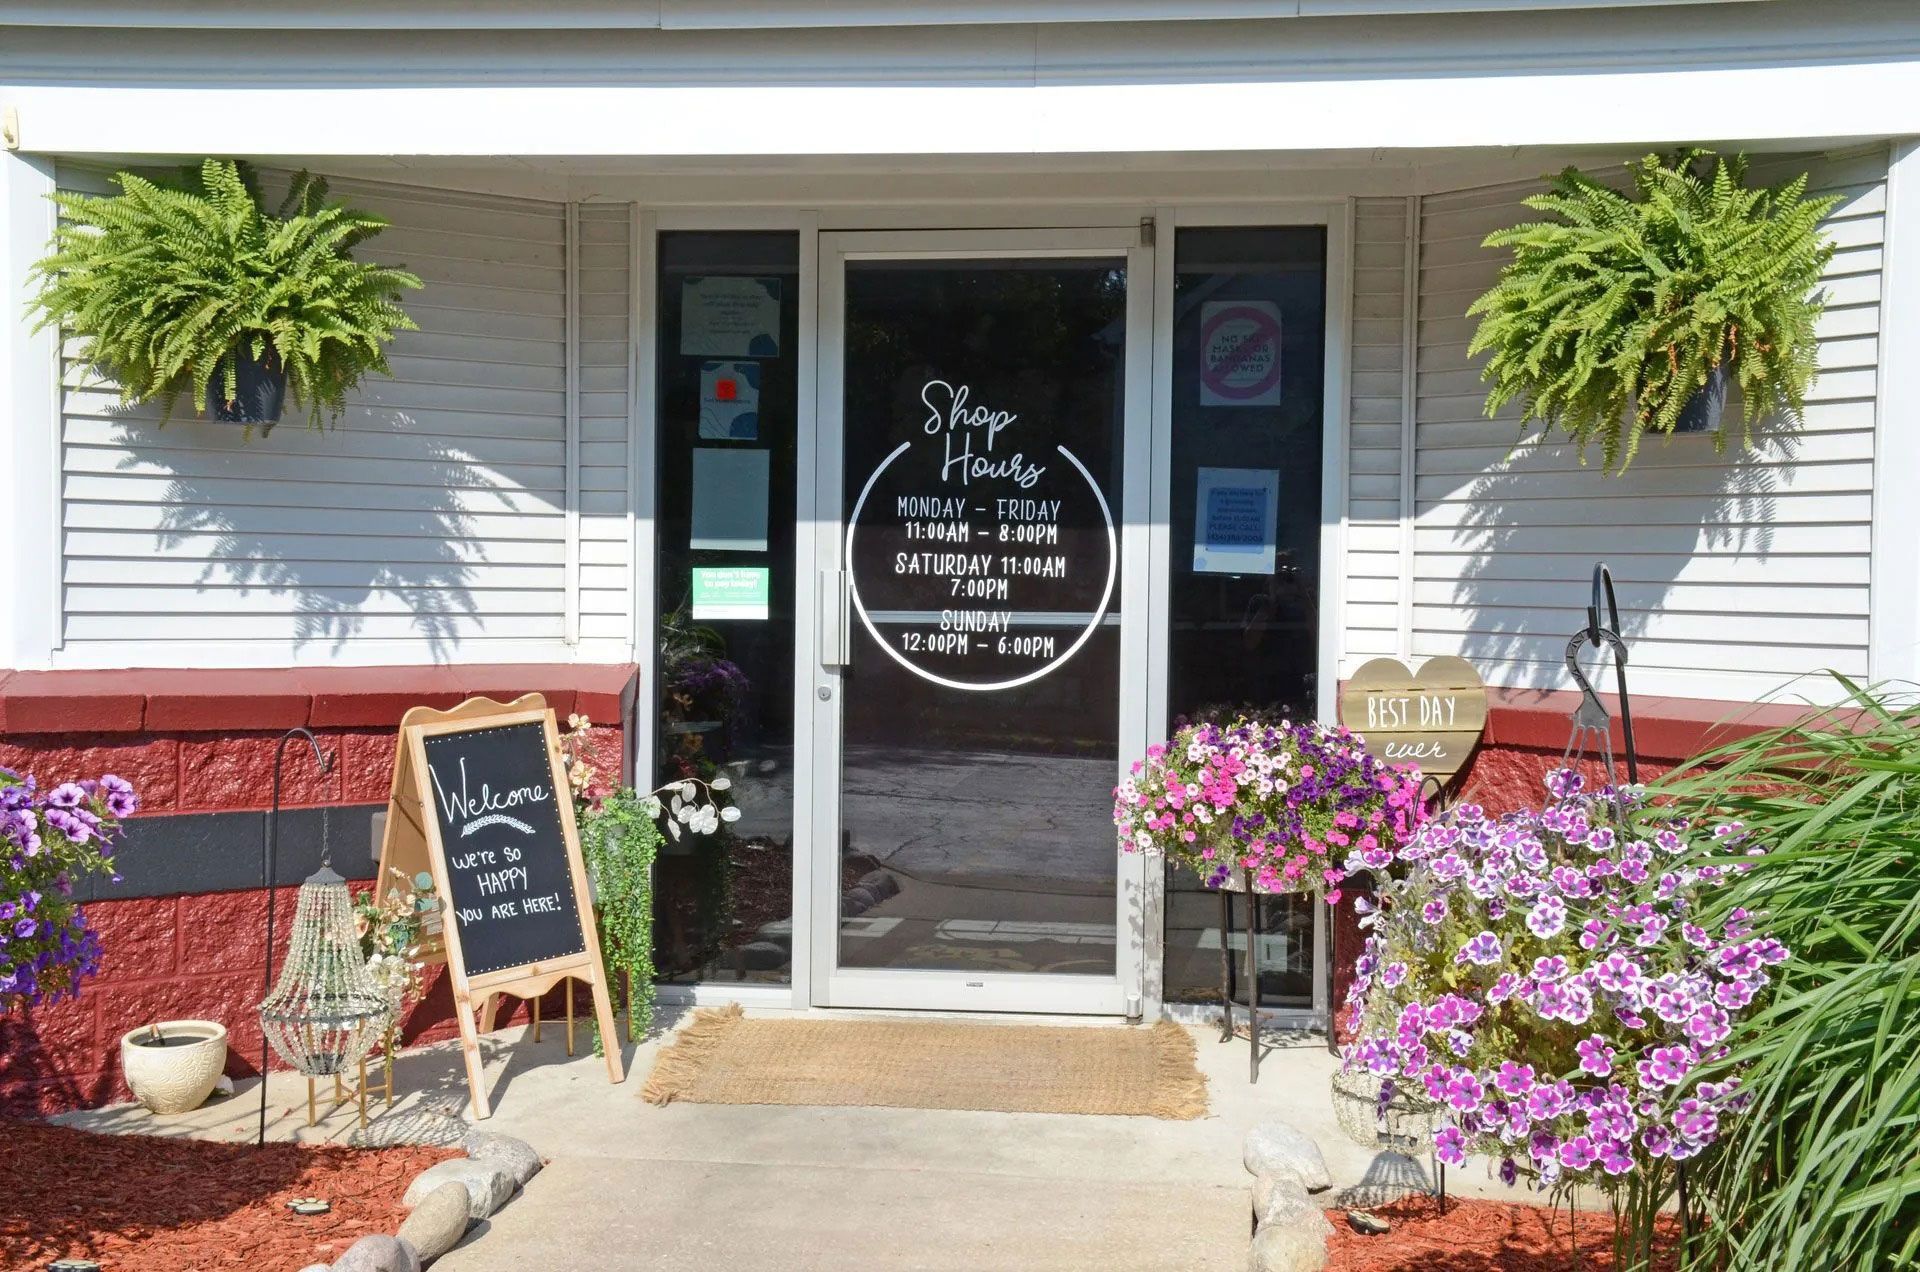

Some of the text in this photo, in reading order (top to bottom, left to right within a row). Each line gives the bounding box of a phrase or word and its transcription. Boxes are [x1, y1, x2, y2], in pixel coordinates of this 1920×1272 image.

[1221, 335, 1238, 343] NO
[921, 380, 1017, 451] Shop
[942, 432, 1046, 488] Hours
[897, 496, 966, 518] MONDAY
[997, 499, 1061, 521] FRIDAY
[905, 521, 969, 543] 11:00AM
[999, 524, 1058, 545] 8:00PM
[895, 553, 1066, 578] SATURDAY 11:00AM
[951, 579, 1008, 600] 7:00PM
[940, 610, 1011, 632] SUNDAY
[902, 633, 968, 655] 12:00PM
[998, 636, 1054, 657] 6:00PM
[1367, 695, 1456, 729] BEST DAY
[1385, 741, 1447, 758] ever
[428, 757, 549, 824] Welcome
[477, 866, 528, 897] HAPPY
[455, 892, 562, 927] YOU ARE HERE!
